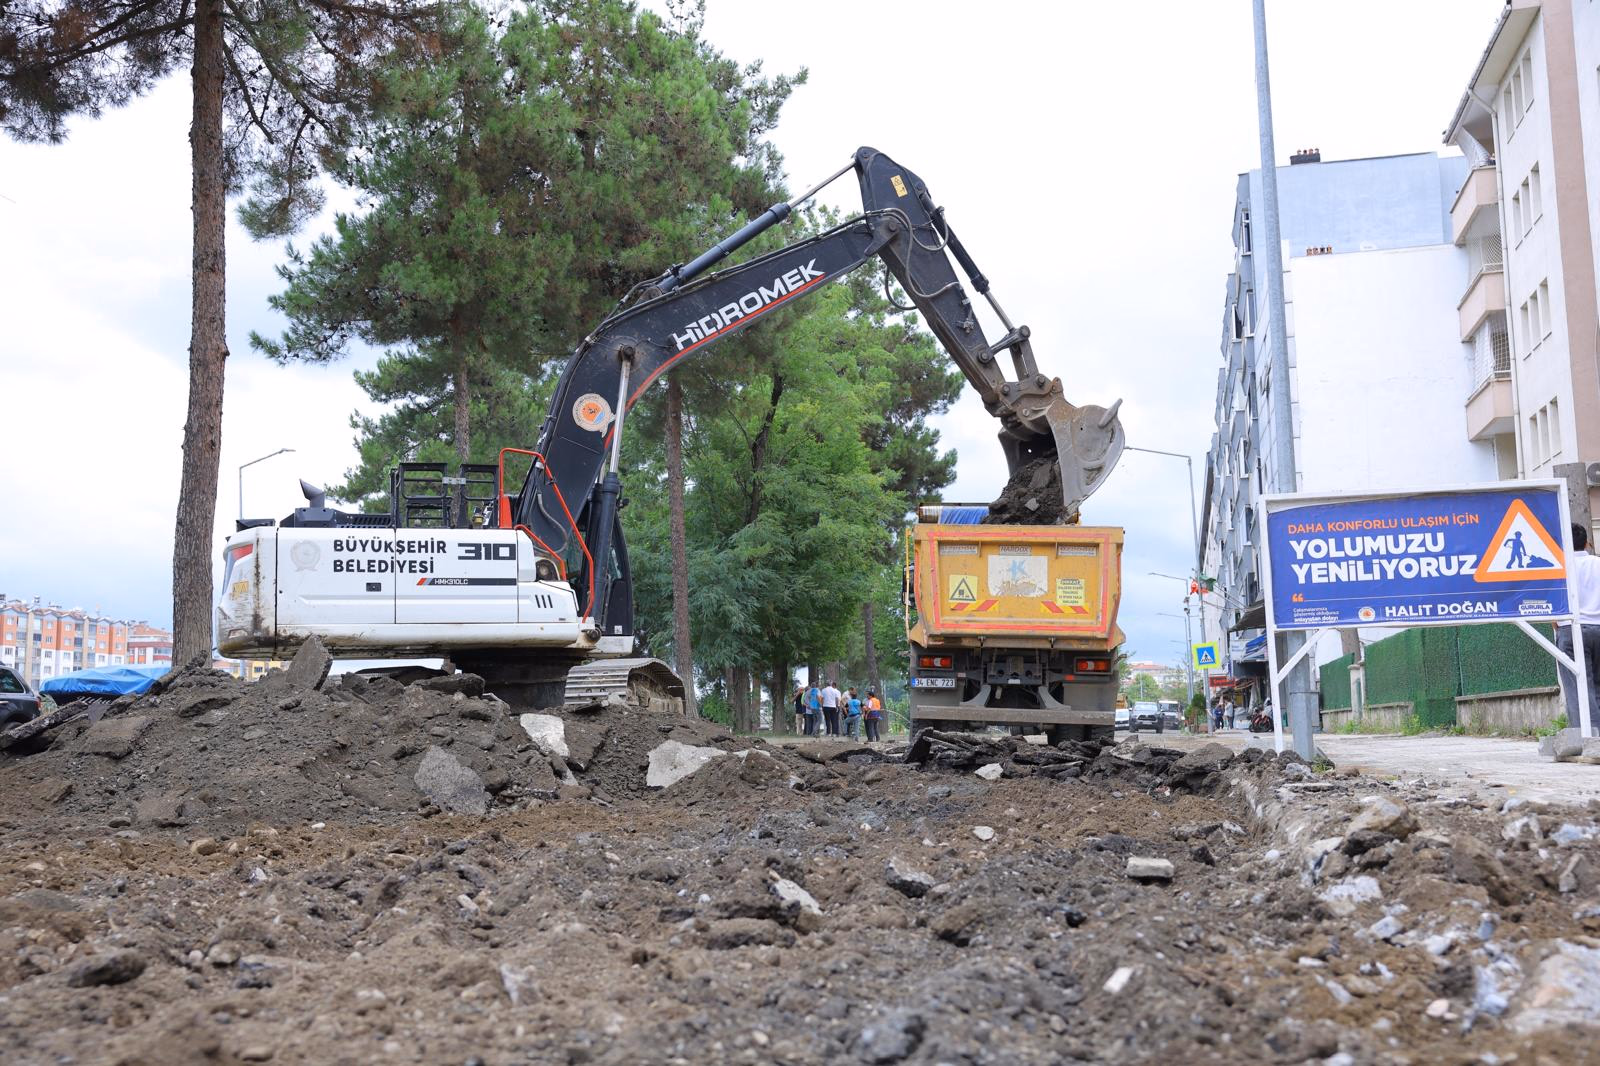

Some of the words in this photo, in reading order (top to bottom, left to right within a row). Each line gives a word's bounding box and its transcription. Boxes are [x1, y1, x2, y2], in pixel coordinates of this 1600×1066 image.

[1288, 522, 1324, 534] DAHA
[1328, 518, 1397, 531] KONFORLU
[1401, 515, 1449, 528] ULAŞIM
[1453, 512, 1479, 526] İÇİN
[333, 536, 447, 555] BÜYÜKŞEHİR
[458, 543, 516, 560] 310
[1289, 532, 1445, 559] YOLUMUZU
[333, 557, 434, 574] BELEDİYESİ
[1291, 554, 1478, 584] YENİLİYORUZ
[1385, 604, 1433, 617] HALİT
[1437, 600, 1498, 615] DOĞAN
[915, 679, 924, 687] 34
[941, 679, 954, 687] 723
